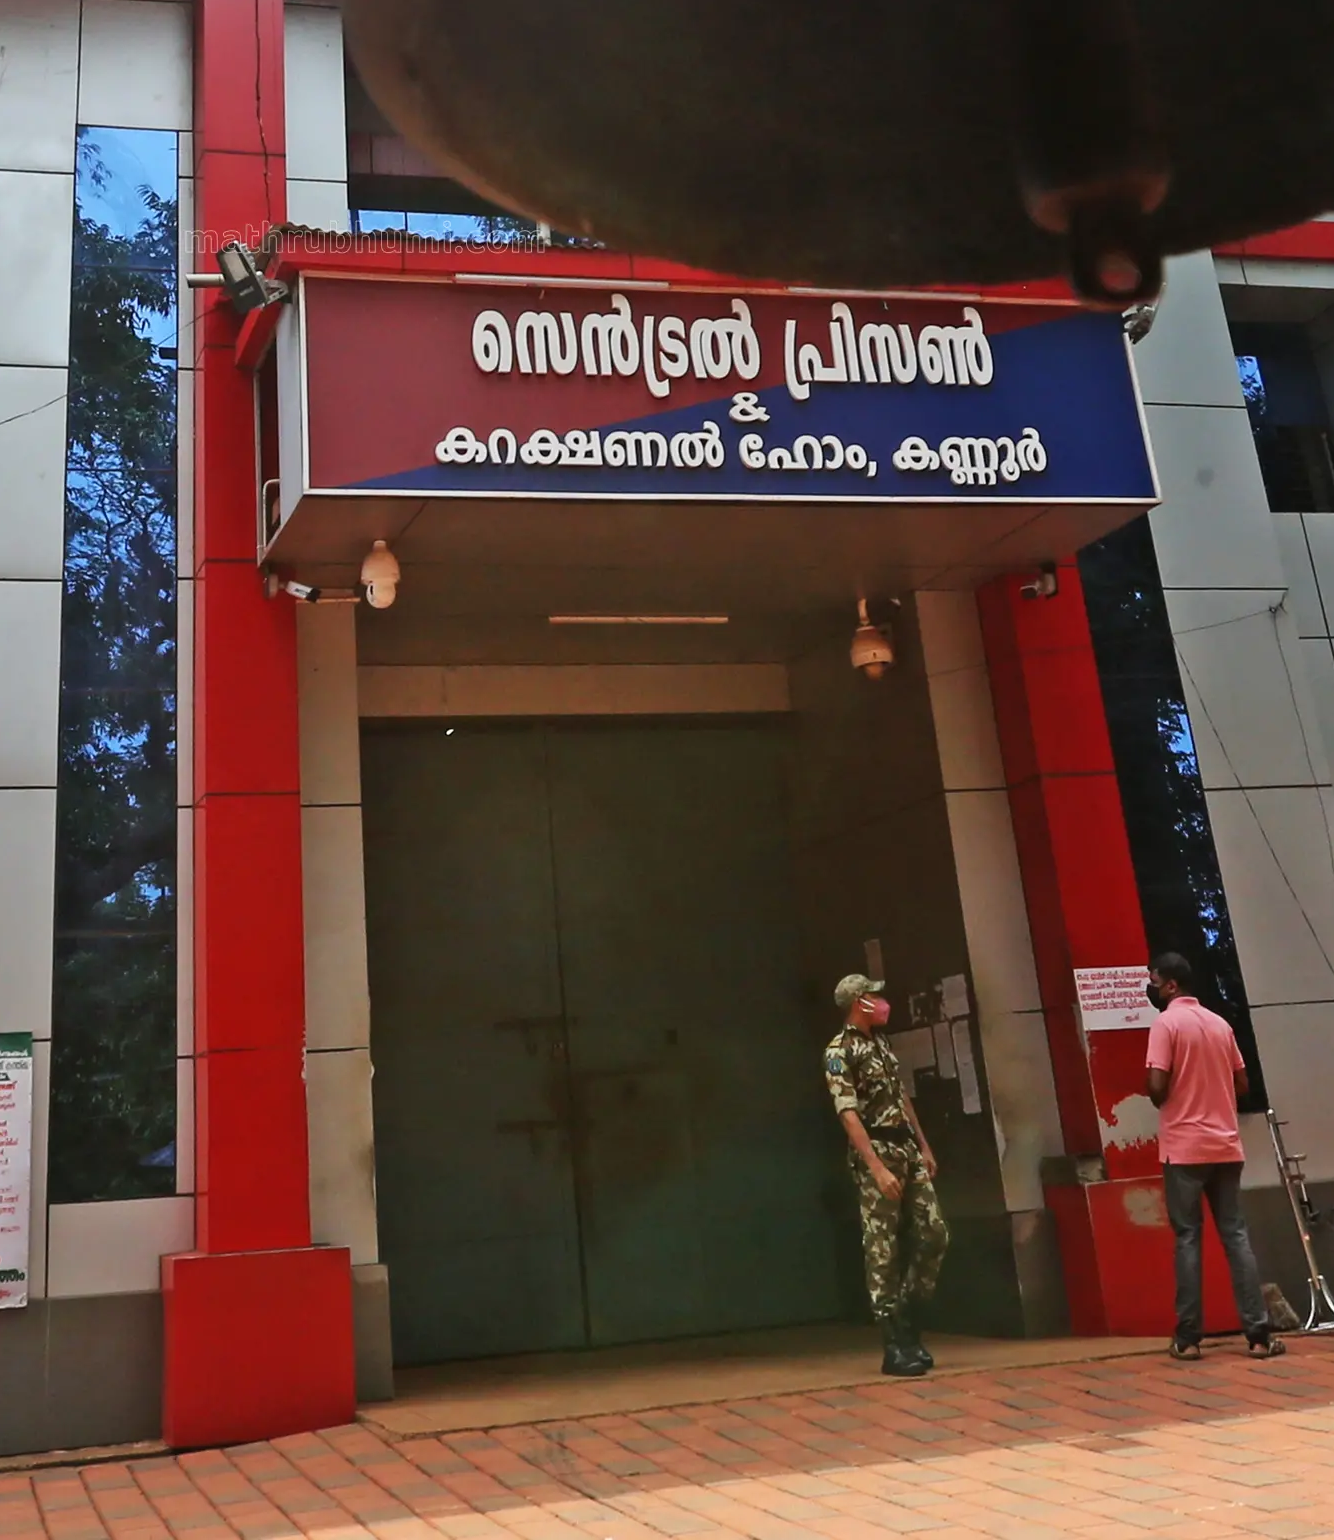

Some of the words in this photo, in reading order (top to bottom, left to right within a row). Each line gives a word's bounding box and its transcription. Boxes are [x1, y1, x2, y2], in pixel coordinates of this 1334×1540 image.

[471, 294, 761, 398] സെൻട്രൽ
[783, 301, 995, 401] പ്രിസൺ
[728, 391, 772, 423] &
[434, 419, 726, 469] കറക്ഷണൽ
[737, 432, 878, 478] ഹോം,
[891, 426, 1048, 486] കണ്ണൂർ
